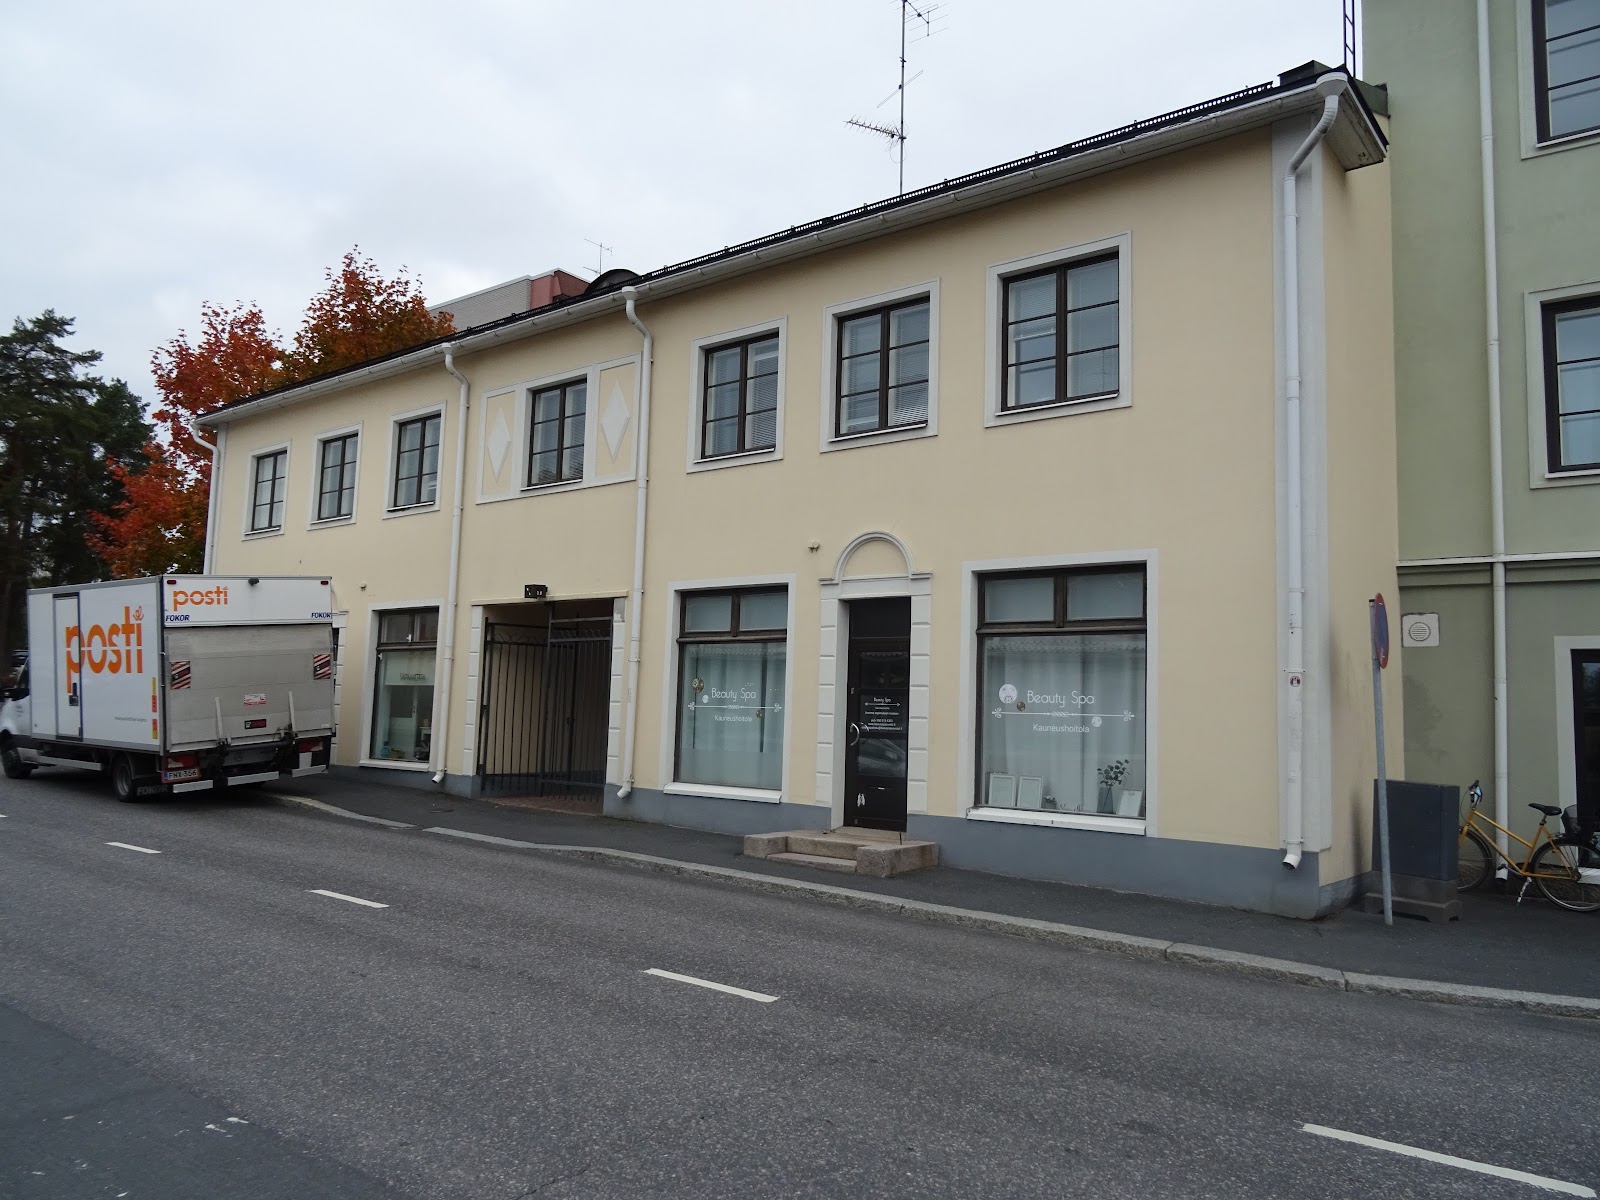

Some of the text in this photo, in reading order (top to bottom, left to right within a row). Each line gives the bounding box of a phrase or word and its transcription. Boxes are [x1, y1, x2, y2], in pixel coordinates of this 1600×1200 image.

[173, 585, 229, 611] posti
[165, 614, 190, 622] FOKOR
[65, 605, 144, 693] posti
[711, 687, 757, 702] Beauty Spa
[1027, 690, 1095, 708] Beauty Spa
[714, 714, 753, 722] Kauneushoitola
[1032, 723, 1090, 733] Kauneushoitola
